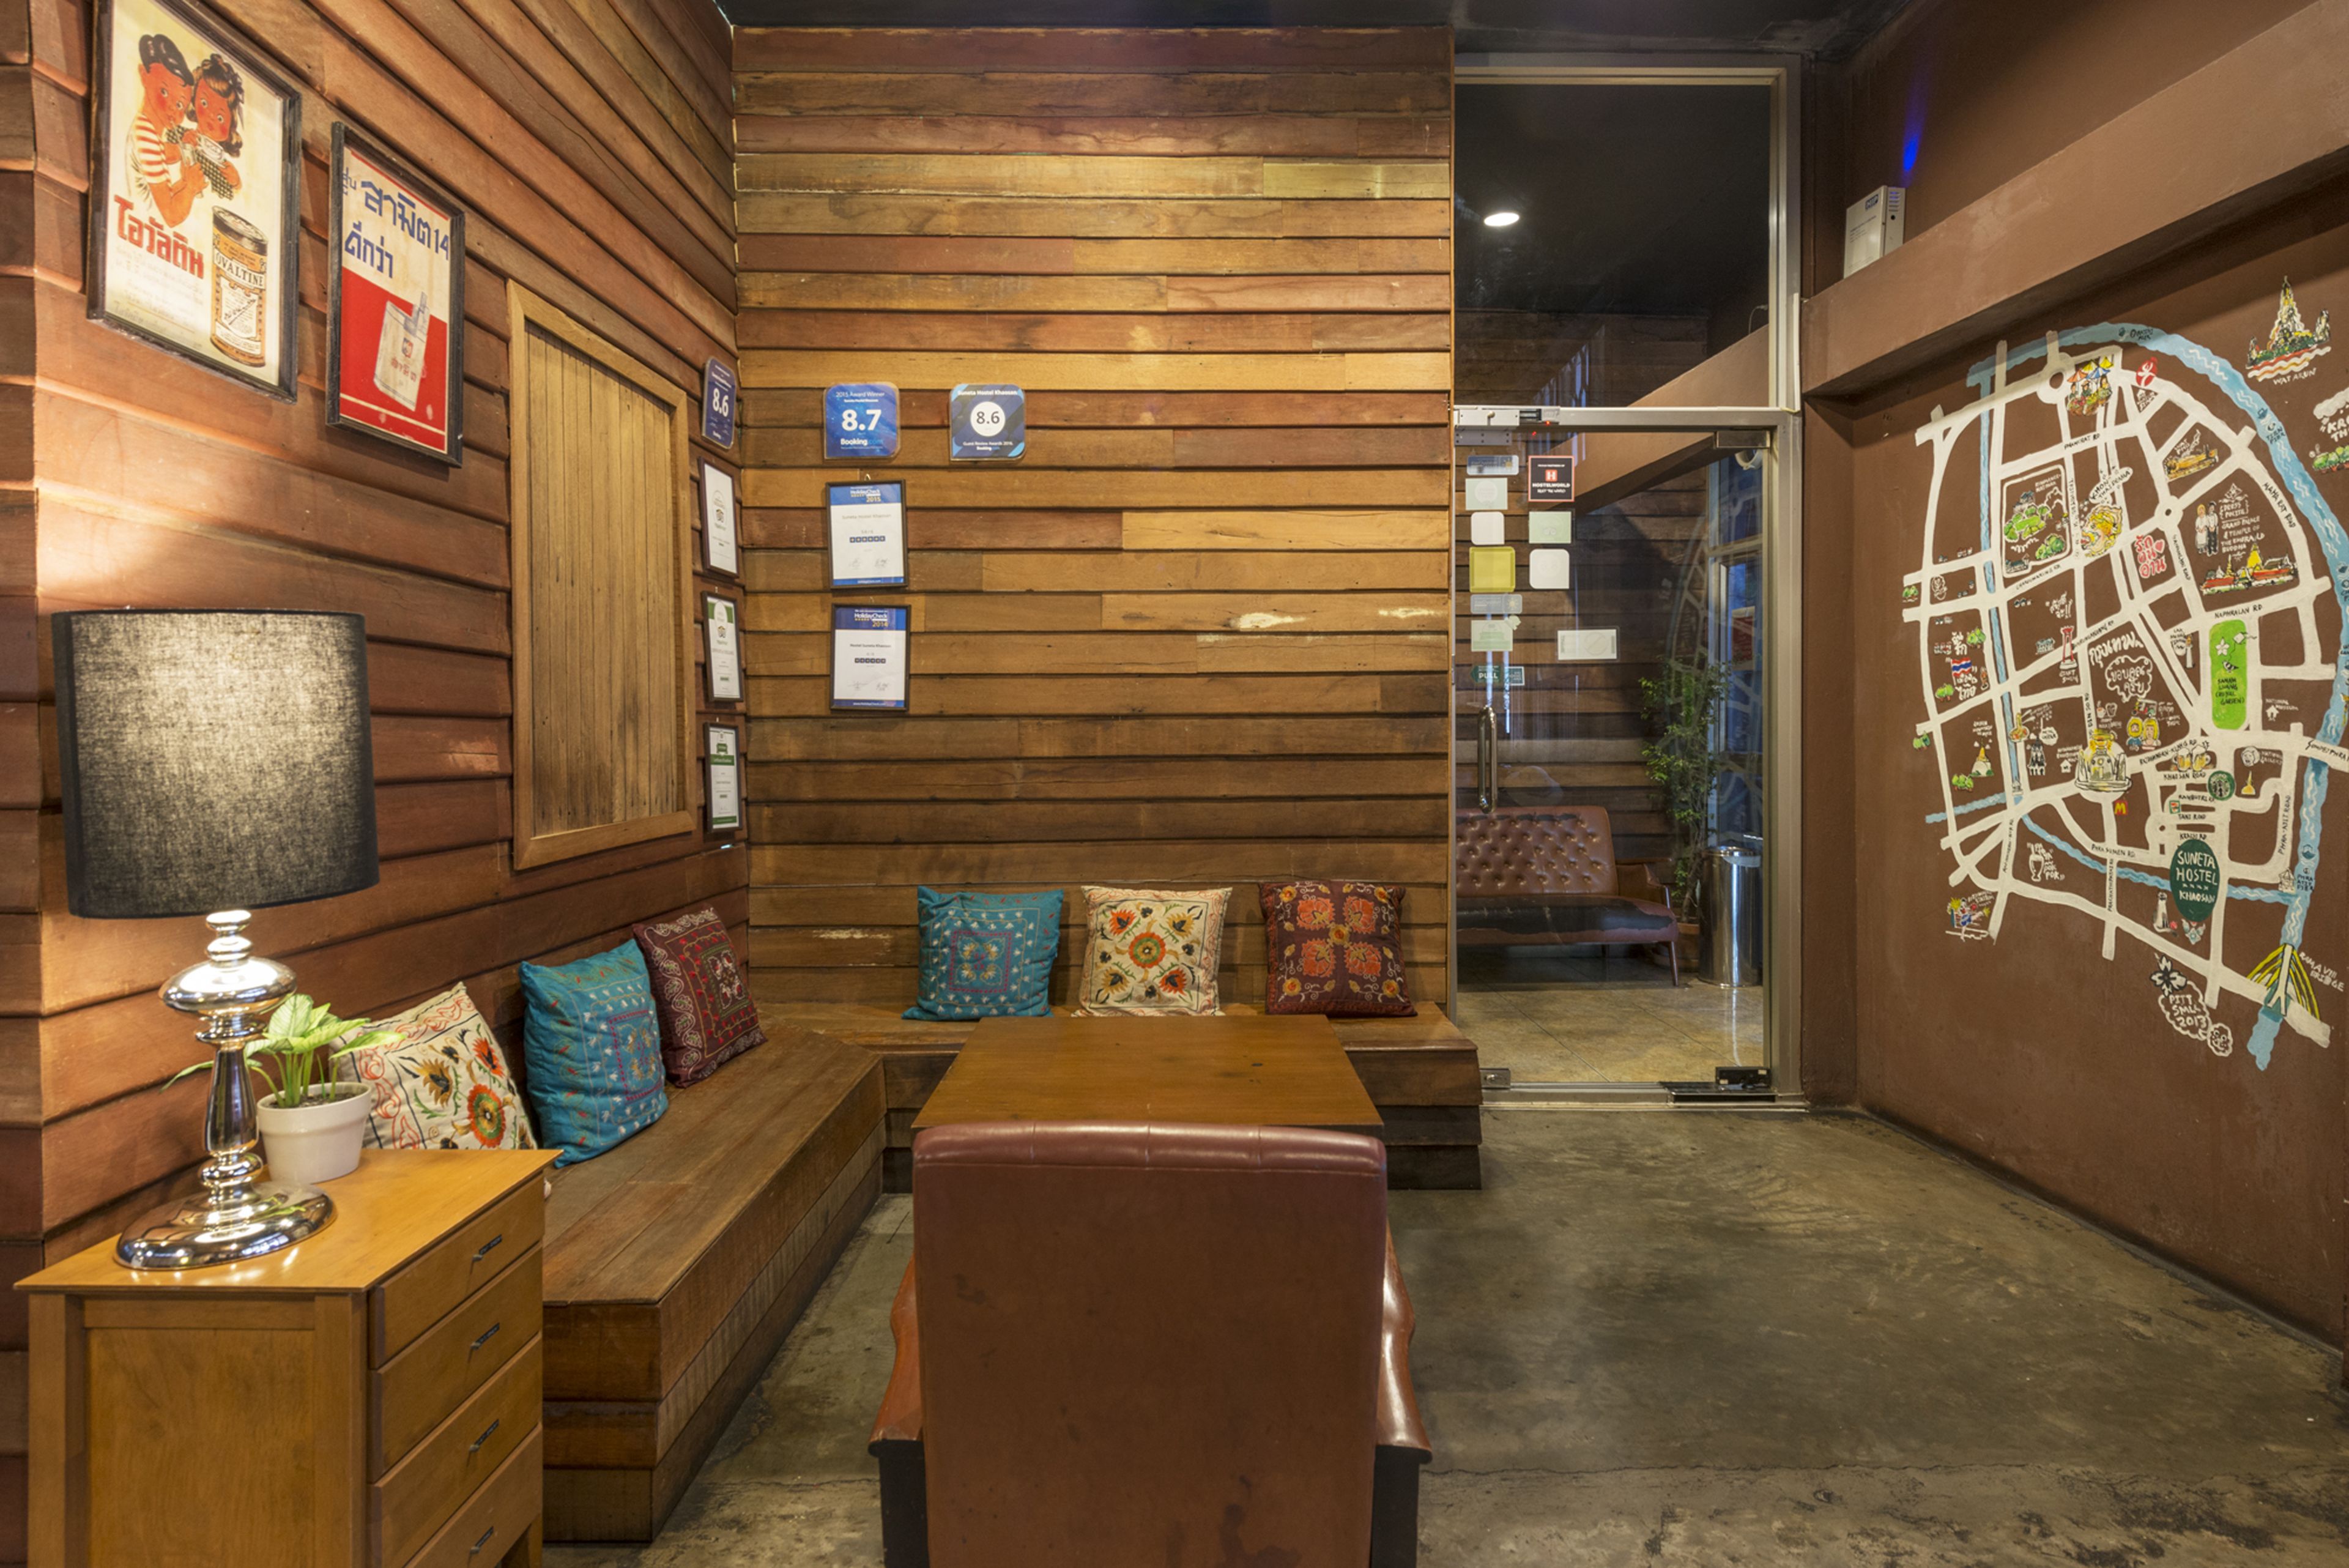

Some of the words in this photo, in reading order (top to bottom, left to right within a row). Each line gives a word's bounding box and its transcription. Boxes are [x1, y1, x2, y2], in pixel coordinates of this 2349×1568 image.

[114, 194, 204, 280] โอวัลติน
[434, 228, 449, 261] 14
[344, 220, 393, 279] ดีกว่า
[216, 251, 264, 287] OVALTINE
[2273, 375, 2291, 385] WAT
[2293, 368, 2317, 381] ARUN
[713, 388, 729, 417] 8.6
[842, 409, 881, 431] 8.7
[976, 411, 1000, 424] 8.6
[2221, 519, 2241, 529] GRAND
[2229, 527, 2251, 537] TEMPLE
[2177, 850, 2216, 869] SUNETA
[2176, 867, 2217, 885] HOSTEL
[2179, 890, 2216, 903] KHAOSAN
[2299, 951, 2321, 973] RAMA
[2310, 970, 2345, 992] BRIDGE
[2169, 994, 2192, 1005] PITT
[2176, 1015, 2207, 1028] 2013
